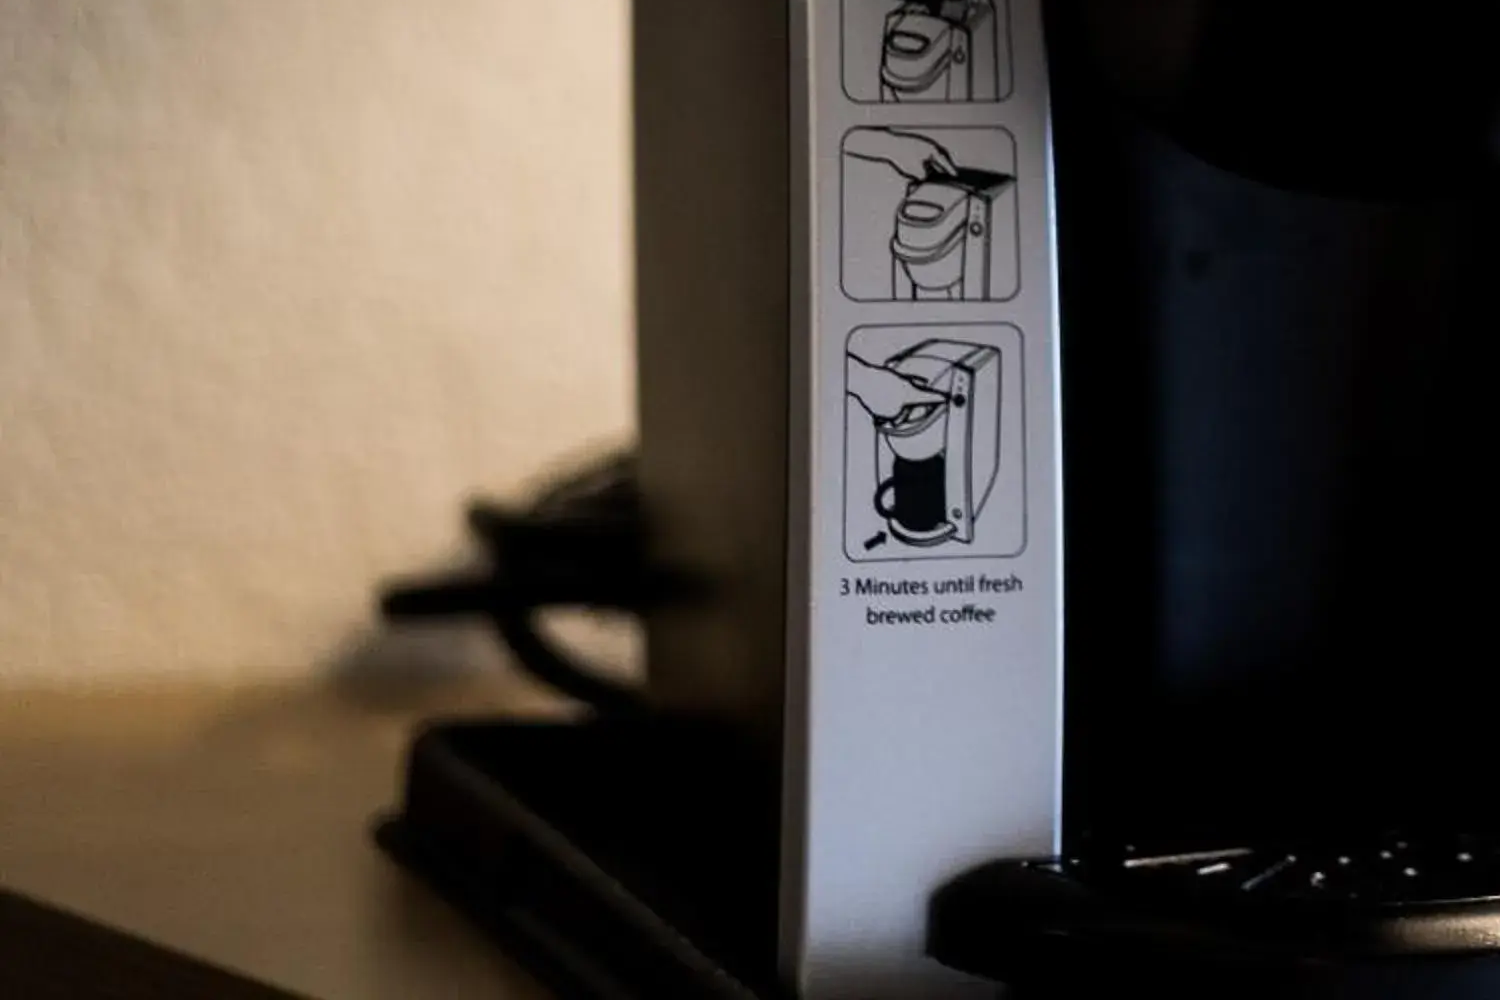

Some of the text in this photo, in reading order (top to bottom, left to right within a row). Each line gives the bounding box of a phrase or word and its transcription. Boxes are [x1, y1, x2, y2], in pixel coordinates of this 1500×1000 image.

[840, 573, 1023, 596] 3 Minutes until fresh
[866, 603, 996, 624] brewed coffee
